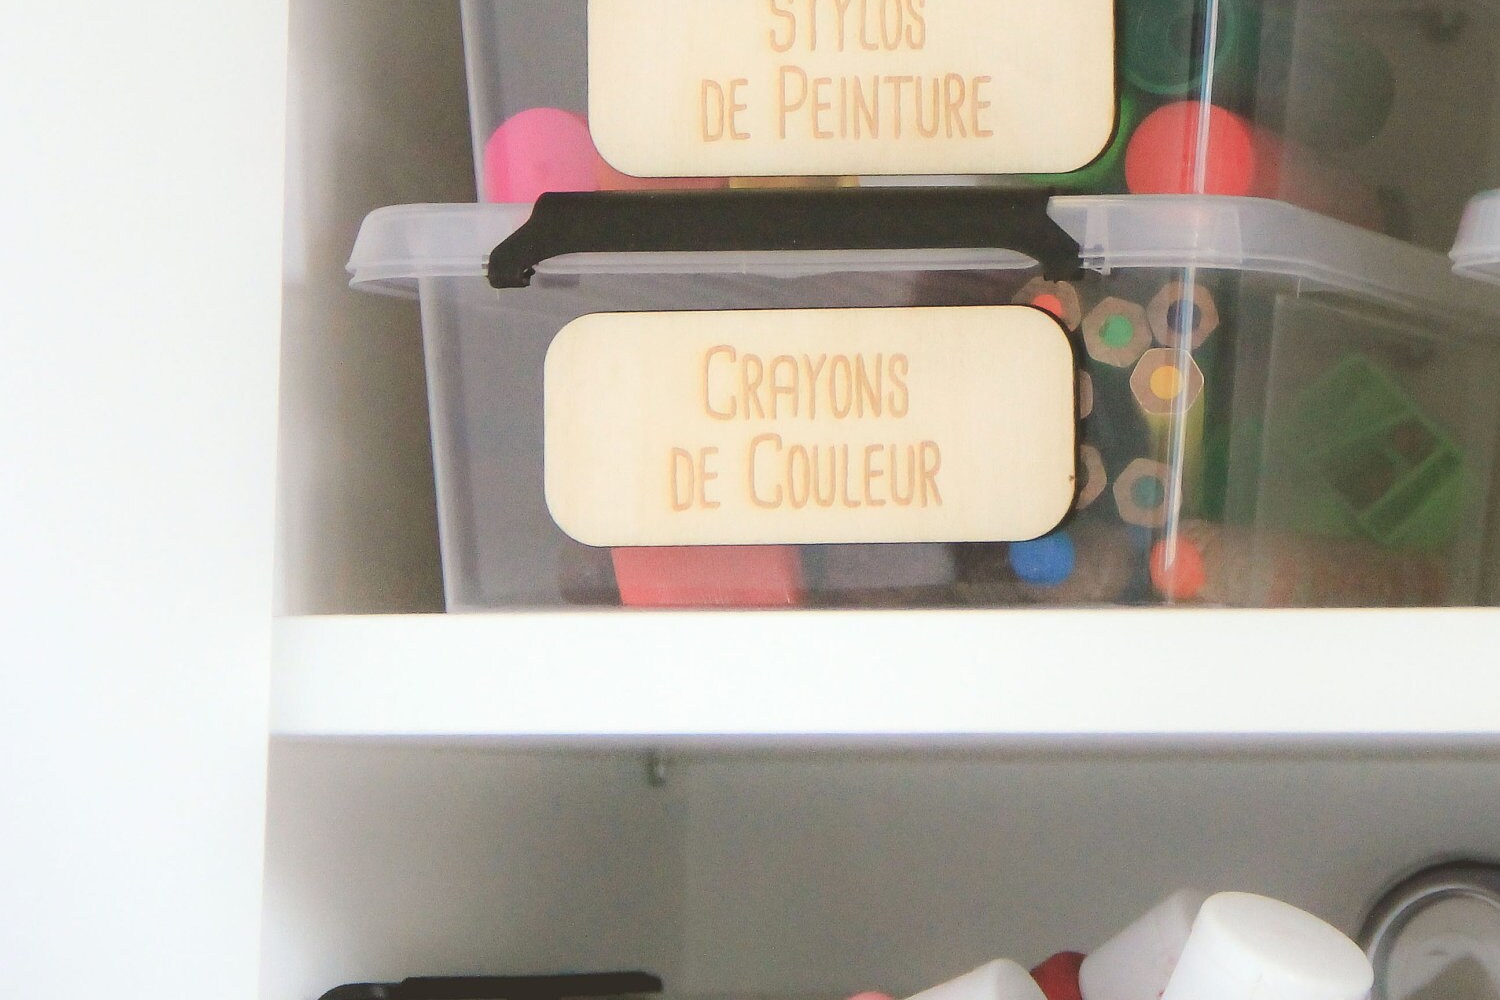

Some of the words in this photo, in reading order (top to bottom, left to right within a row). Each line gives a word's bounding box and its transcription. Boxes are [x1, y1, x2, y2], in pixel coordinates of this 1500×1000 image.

[701, 77, 751, 142] DE
[778, 64, 994, 140] PEINTURE
[704, 344, 910, 421] CRAYONS
[670, 446, 721, 512] DE
[748, 433, 944, 510] COULEUR
